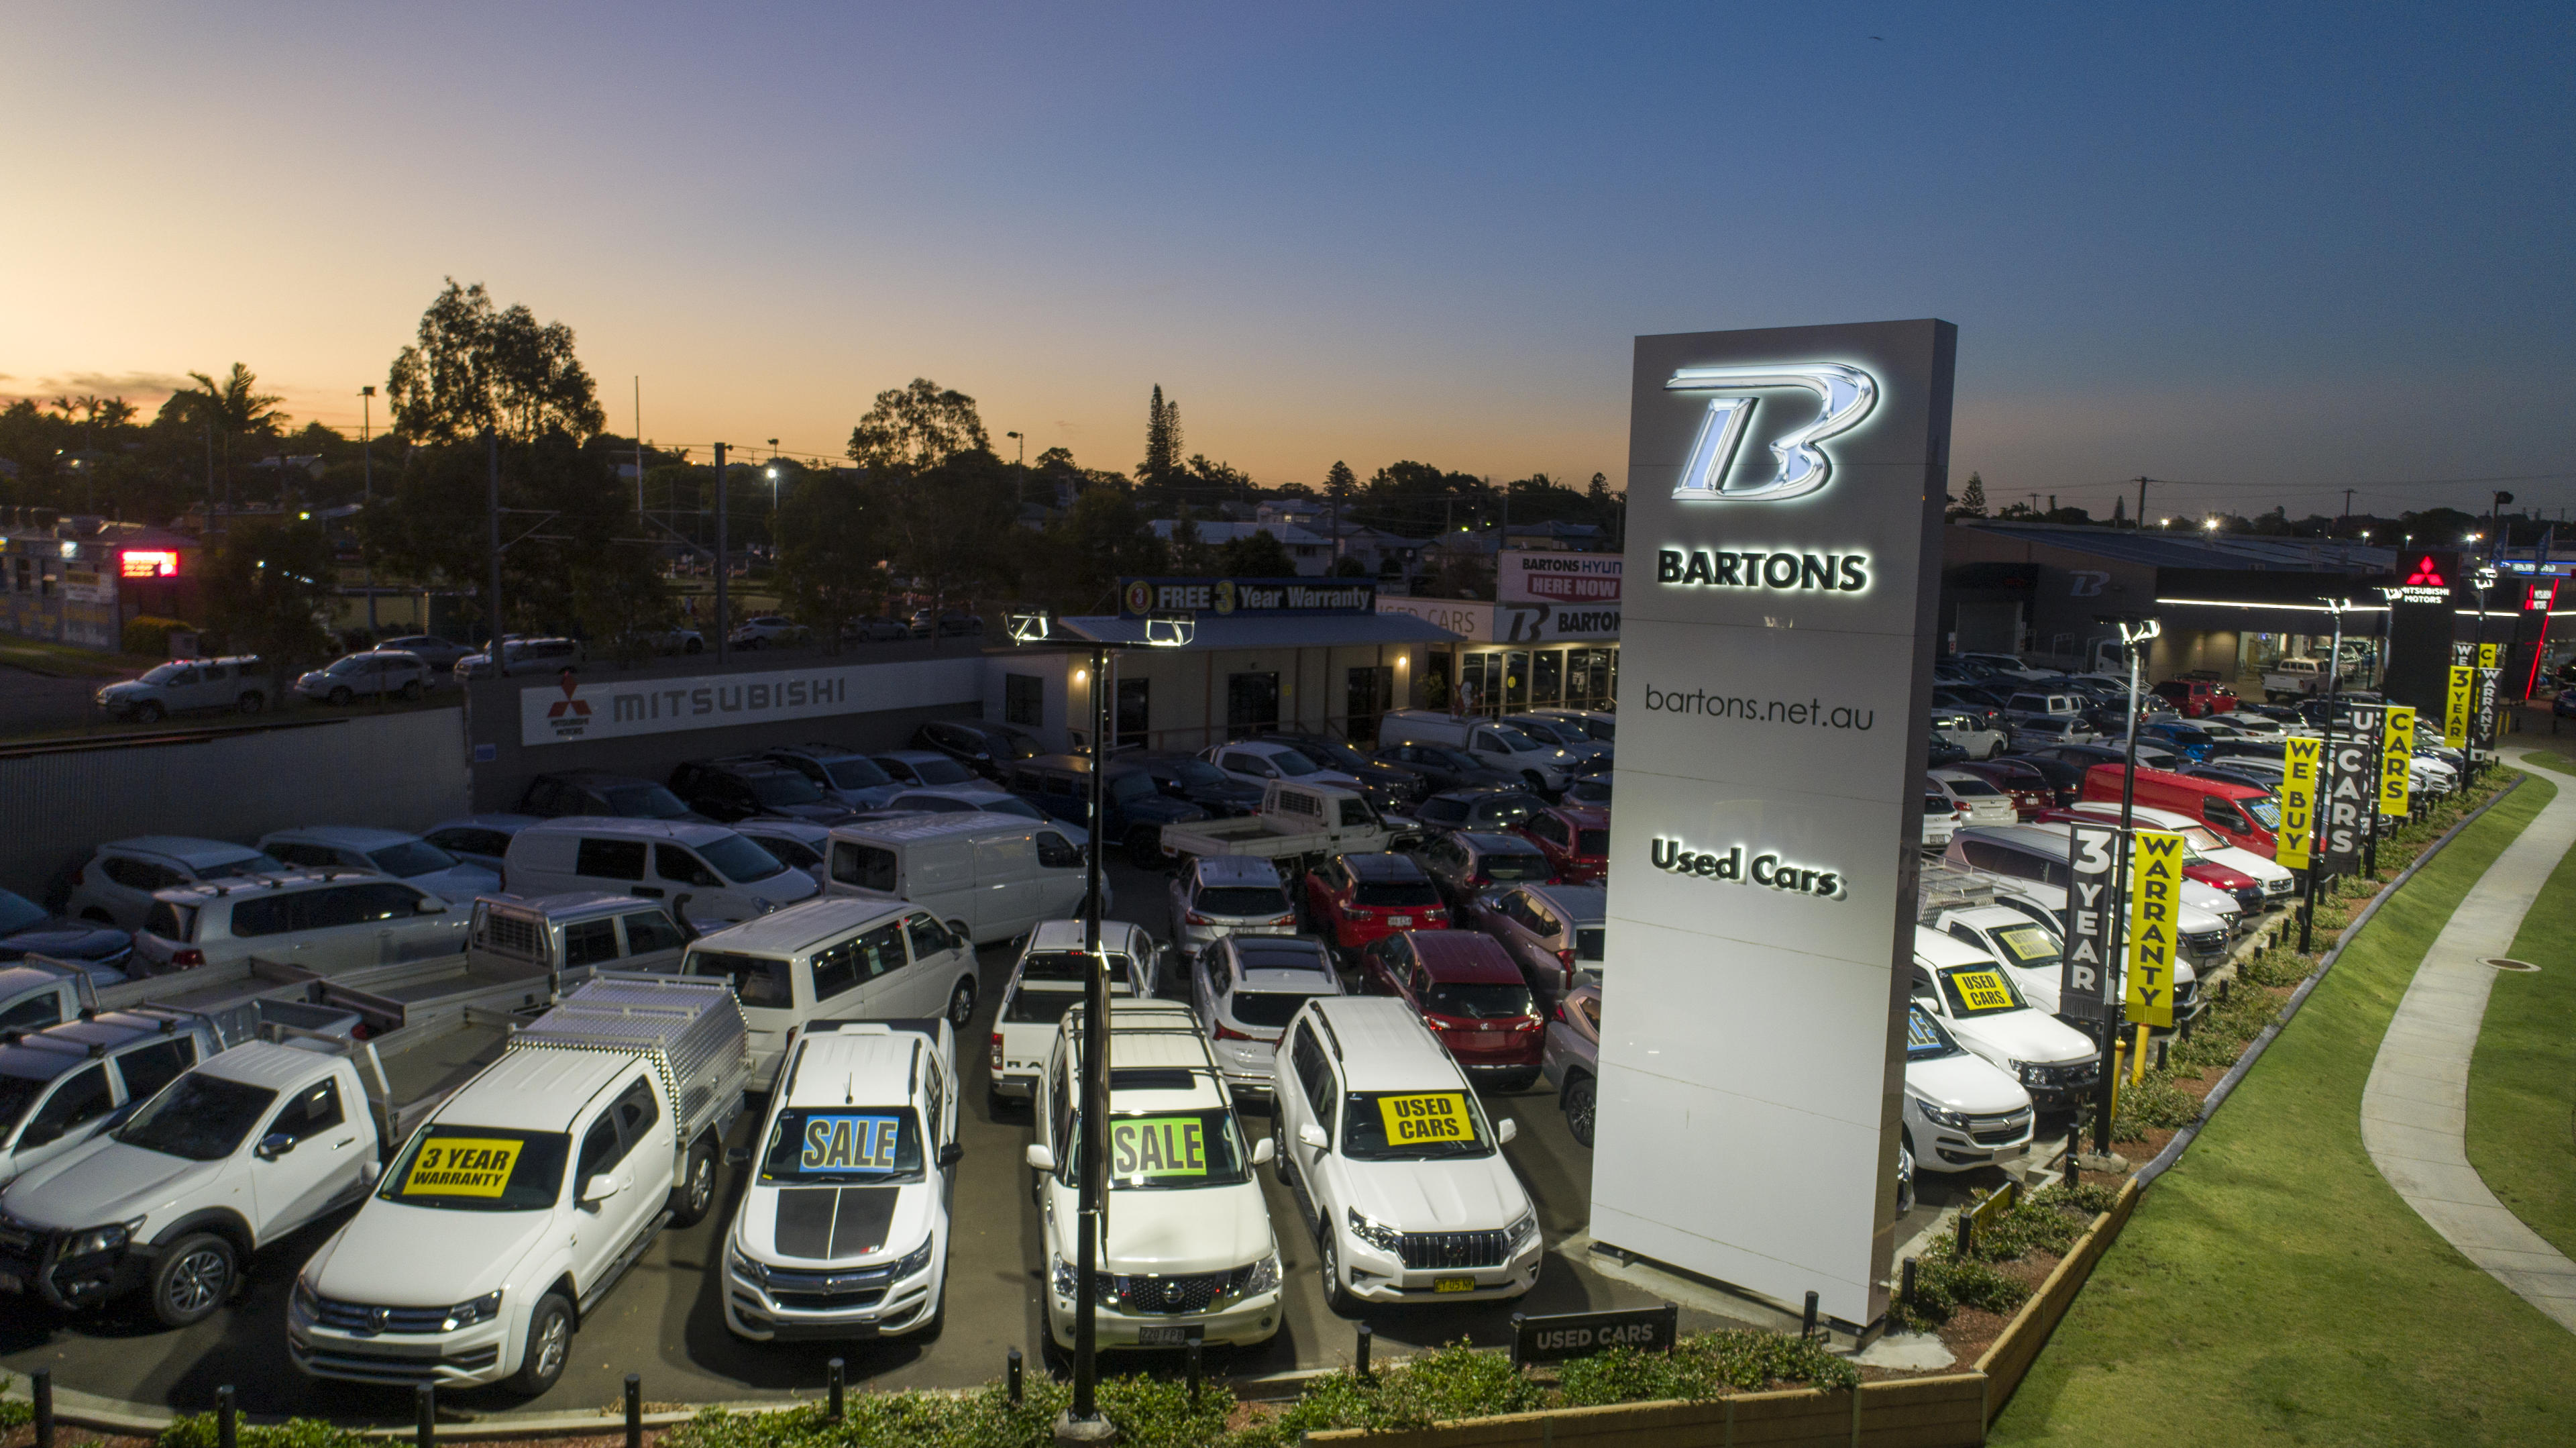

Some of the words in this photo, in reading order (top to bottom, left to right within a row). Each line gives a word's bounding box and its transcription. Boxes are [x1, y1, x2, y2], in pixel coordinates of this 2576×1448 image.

[1663, 362, 1879, 501] B
[1523, 558, 1579, 572] BARTONS
[1582, 560, 1622, 574] HYUN
[1658, 550, 1868, 592] BARTONS
[2512, 563, 2556, 572] SUBRU
[1159, 586, 1212, 609] FREE
[1215, 580, 1236, 615] 3
[1239, 586, 1283, 609] Year
[1286, 586, 1372, 611] Warranty
[1532, 577, 1572, 595] HERE
[1576, 579, 1617, 598] NOW
[2402, 586, 2450, 596] MITSUBISHI
[2404, 595, 2442, 604] MOTORS
[1428, 609, 1474, 633] CARS
[1558, 611, 1621, 633] BARTON
[2453, 670, 2469, 687] 3
[613, 677, 845, 722] MITSUBISHI
[1646, 684, 1874, 731] bartons.net.au
[2451, 692, 2465, 737] YEAR
[2479, 670, 2500, 741] WARRANTY
[2290, 741, 2318, 779] WE
[2386, 713, 2410, 799] CARS
[2330, 749, 2363, 853] CARS
[2286, 791, 2306, 850] BUY
[1651, 837, 1742, 880] Used
[1751, 854, 1839, 896] Cars
[2073, 829, 2112, 874] 3
[2071, 883, 2105, 992] YEAR
[2137, 836, 2180, 1006] WARRANTY
[1962, 975, 1996, 990] USED
[1970, 990, 2006, 1006] CARS
[1393, 1098, 1453, 1118] USED
[802, 1119, 898, 1169] SALE
[1399, 1118, 1460, 1139] CARS
[422, 1148, 443, 1169] 3
[447, 1149, 511, 1170] YEAR
[1114, 1123, 1205, 1173] SALE
[413, 1172, 504, 1187] WARRANTY
[1537, 1329, 1592, 1350] USED
[1599, 1324, 1654, 1345] CARS
